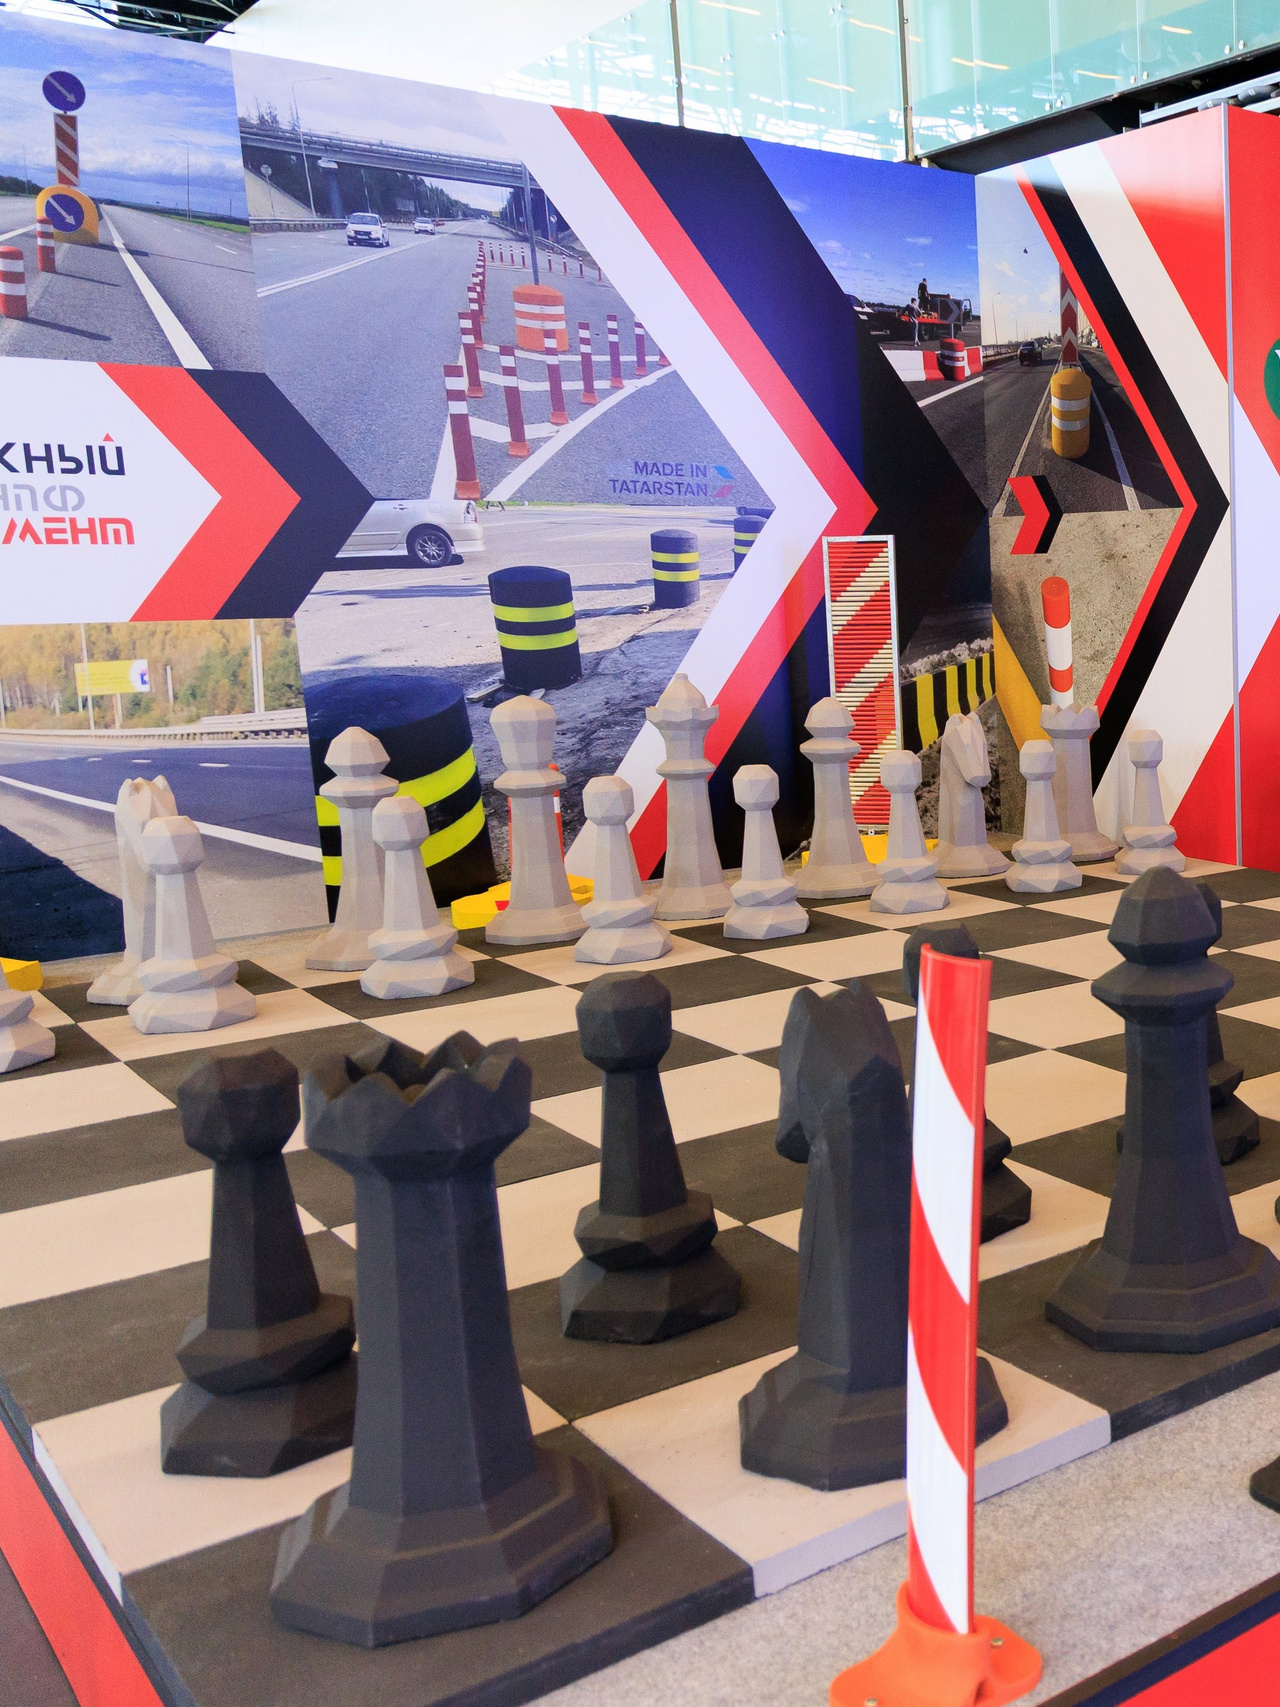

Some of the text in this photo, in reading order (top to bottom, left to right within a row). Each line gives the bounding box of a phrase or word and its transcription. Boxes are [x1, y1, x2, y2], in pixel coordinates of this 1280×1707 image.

[634, 461, 706, 478] MADE IN
[608, 480, 708, 496] TATARSTAN
